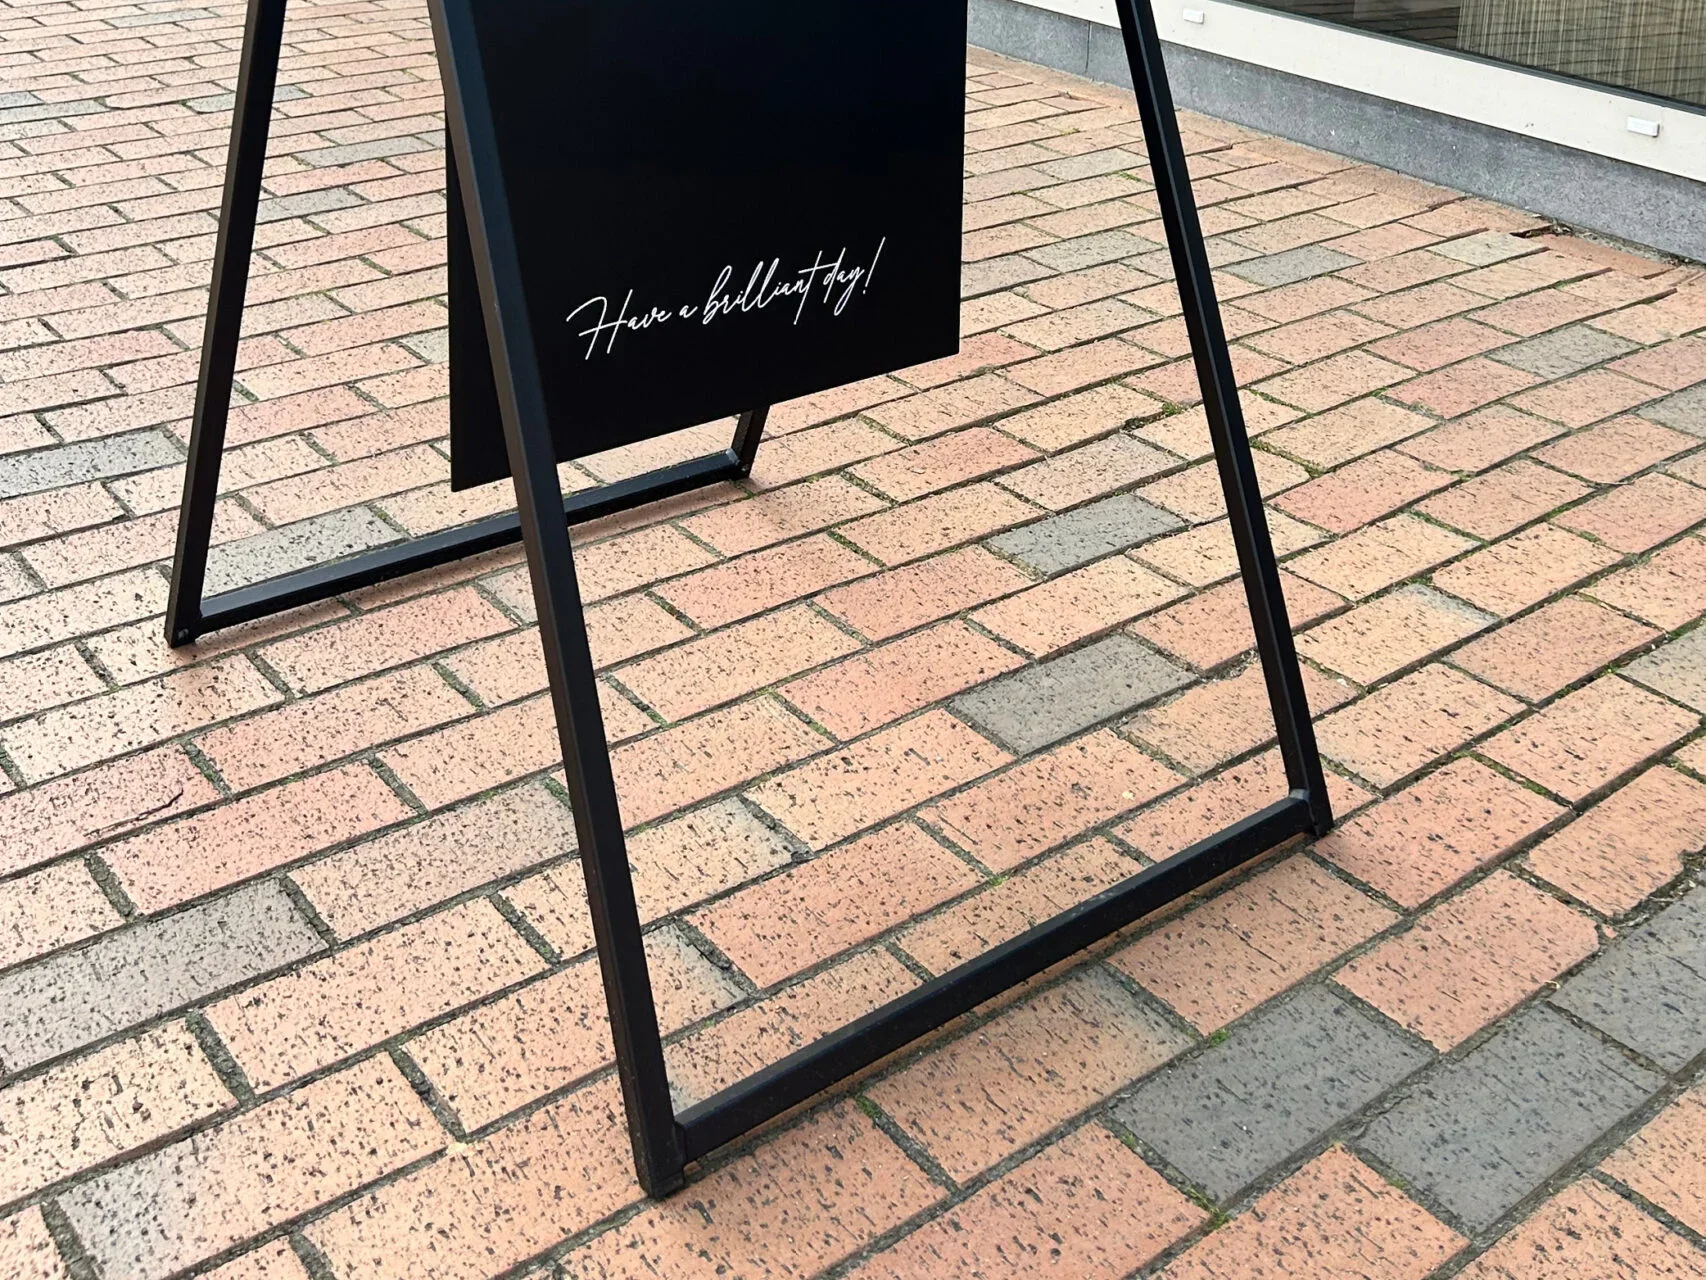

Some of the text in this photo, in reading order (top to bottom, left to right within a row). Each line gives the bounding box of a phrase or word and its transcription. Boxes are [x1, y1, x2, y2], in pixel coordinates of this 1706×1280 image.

[566, 236, 886, 360] Have a brilliant day!
